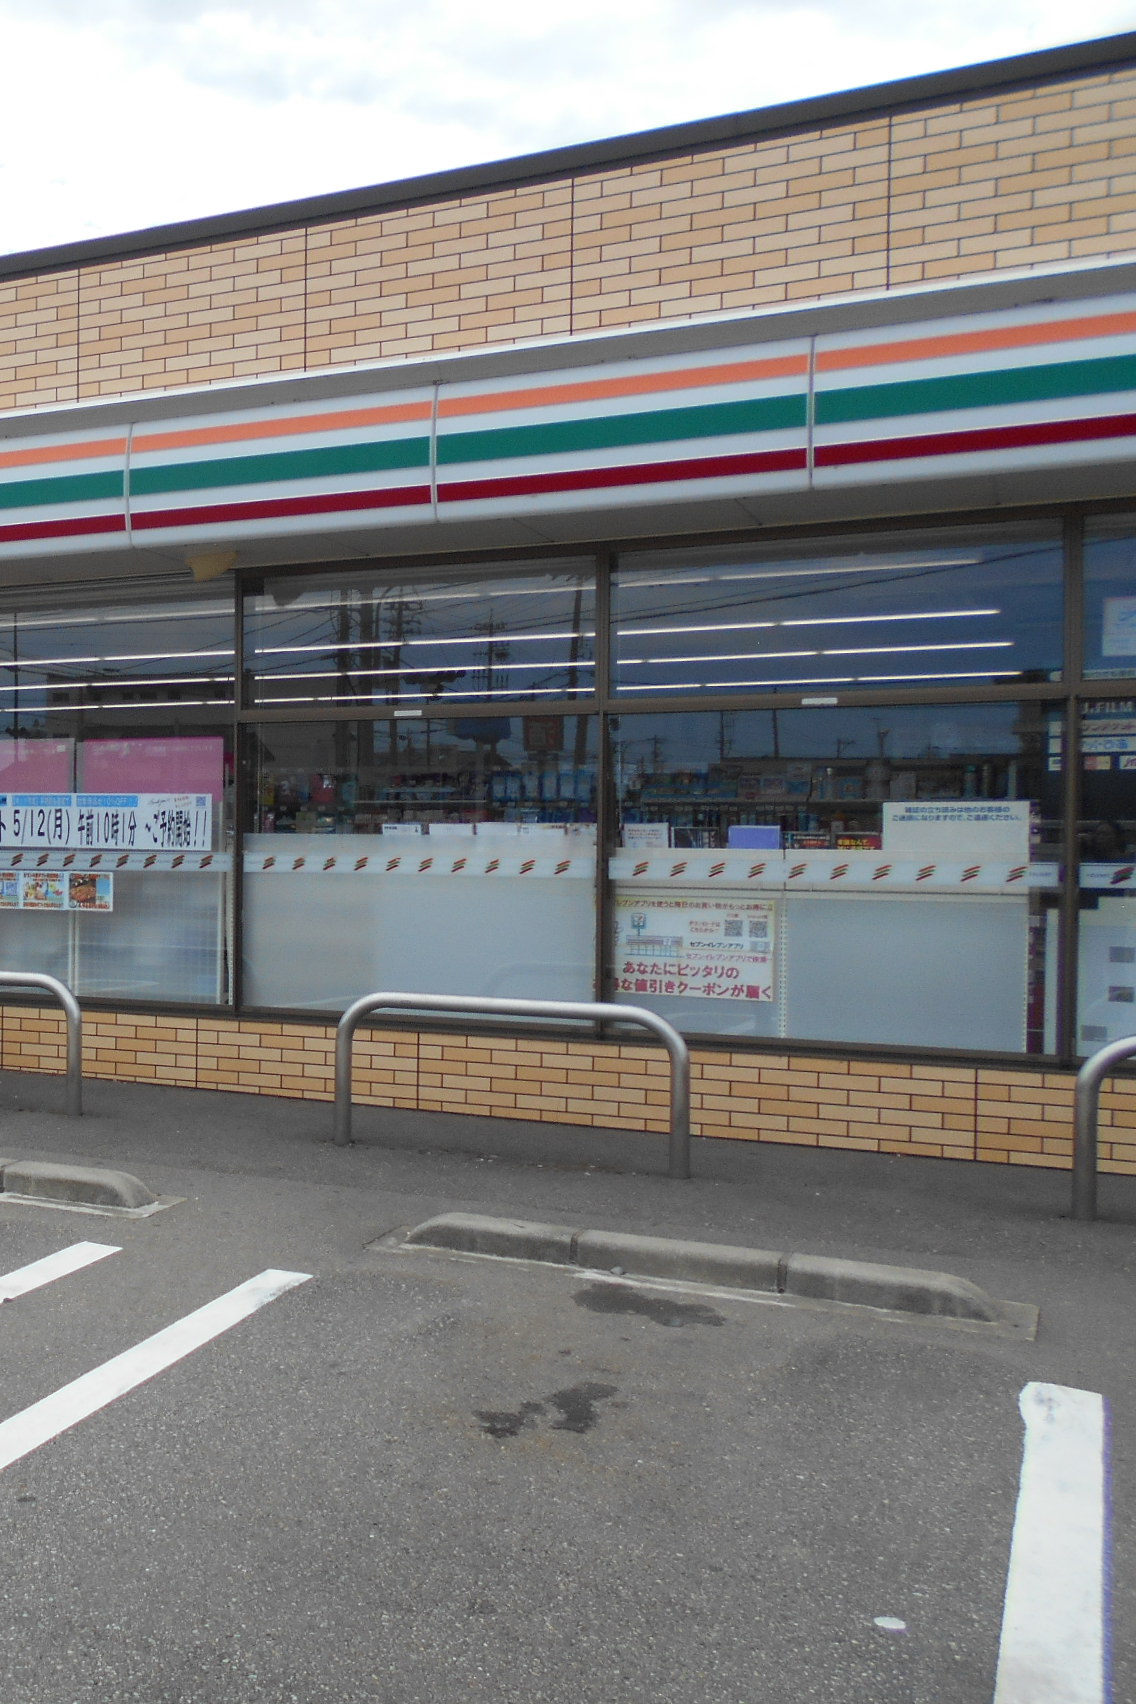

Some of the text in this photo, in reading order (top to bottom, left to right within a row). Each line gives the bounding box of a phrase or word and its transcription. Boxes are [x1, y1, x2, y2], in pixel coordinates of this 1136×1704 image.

[13, 808, 70, 845] 5/12(月)
[622, 961, 739, 979] あなたにピッタリの
